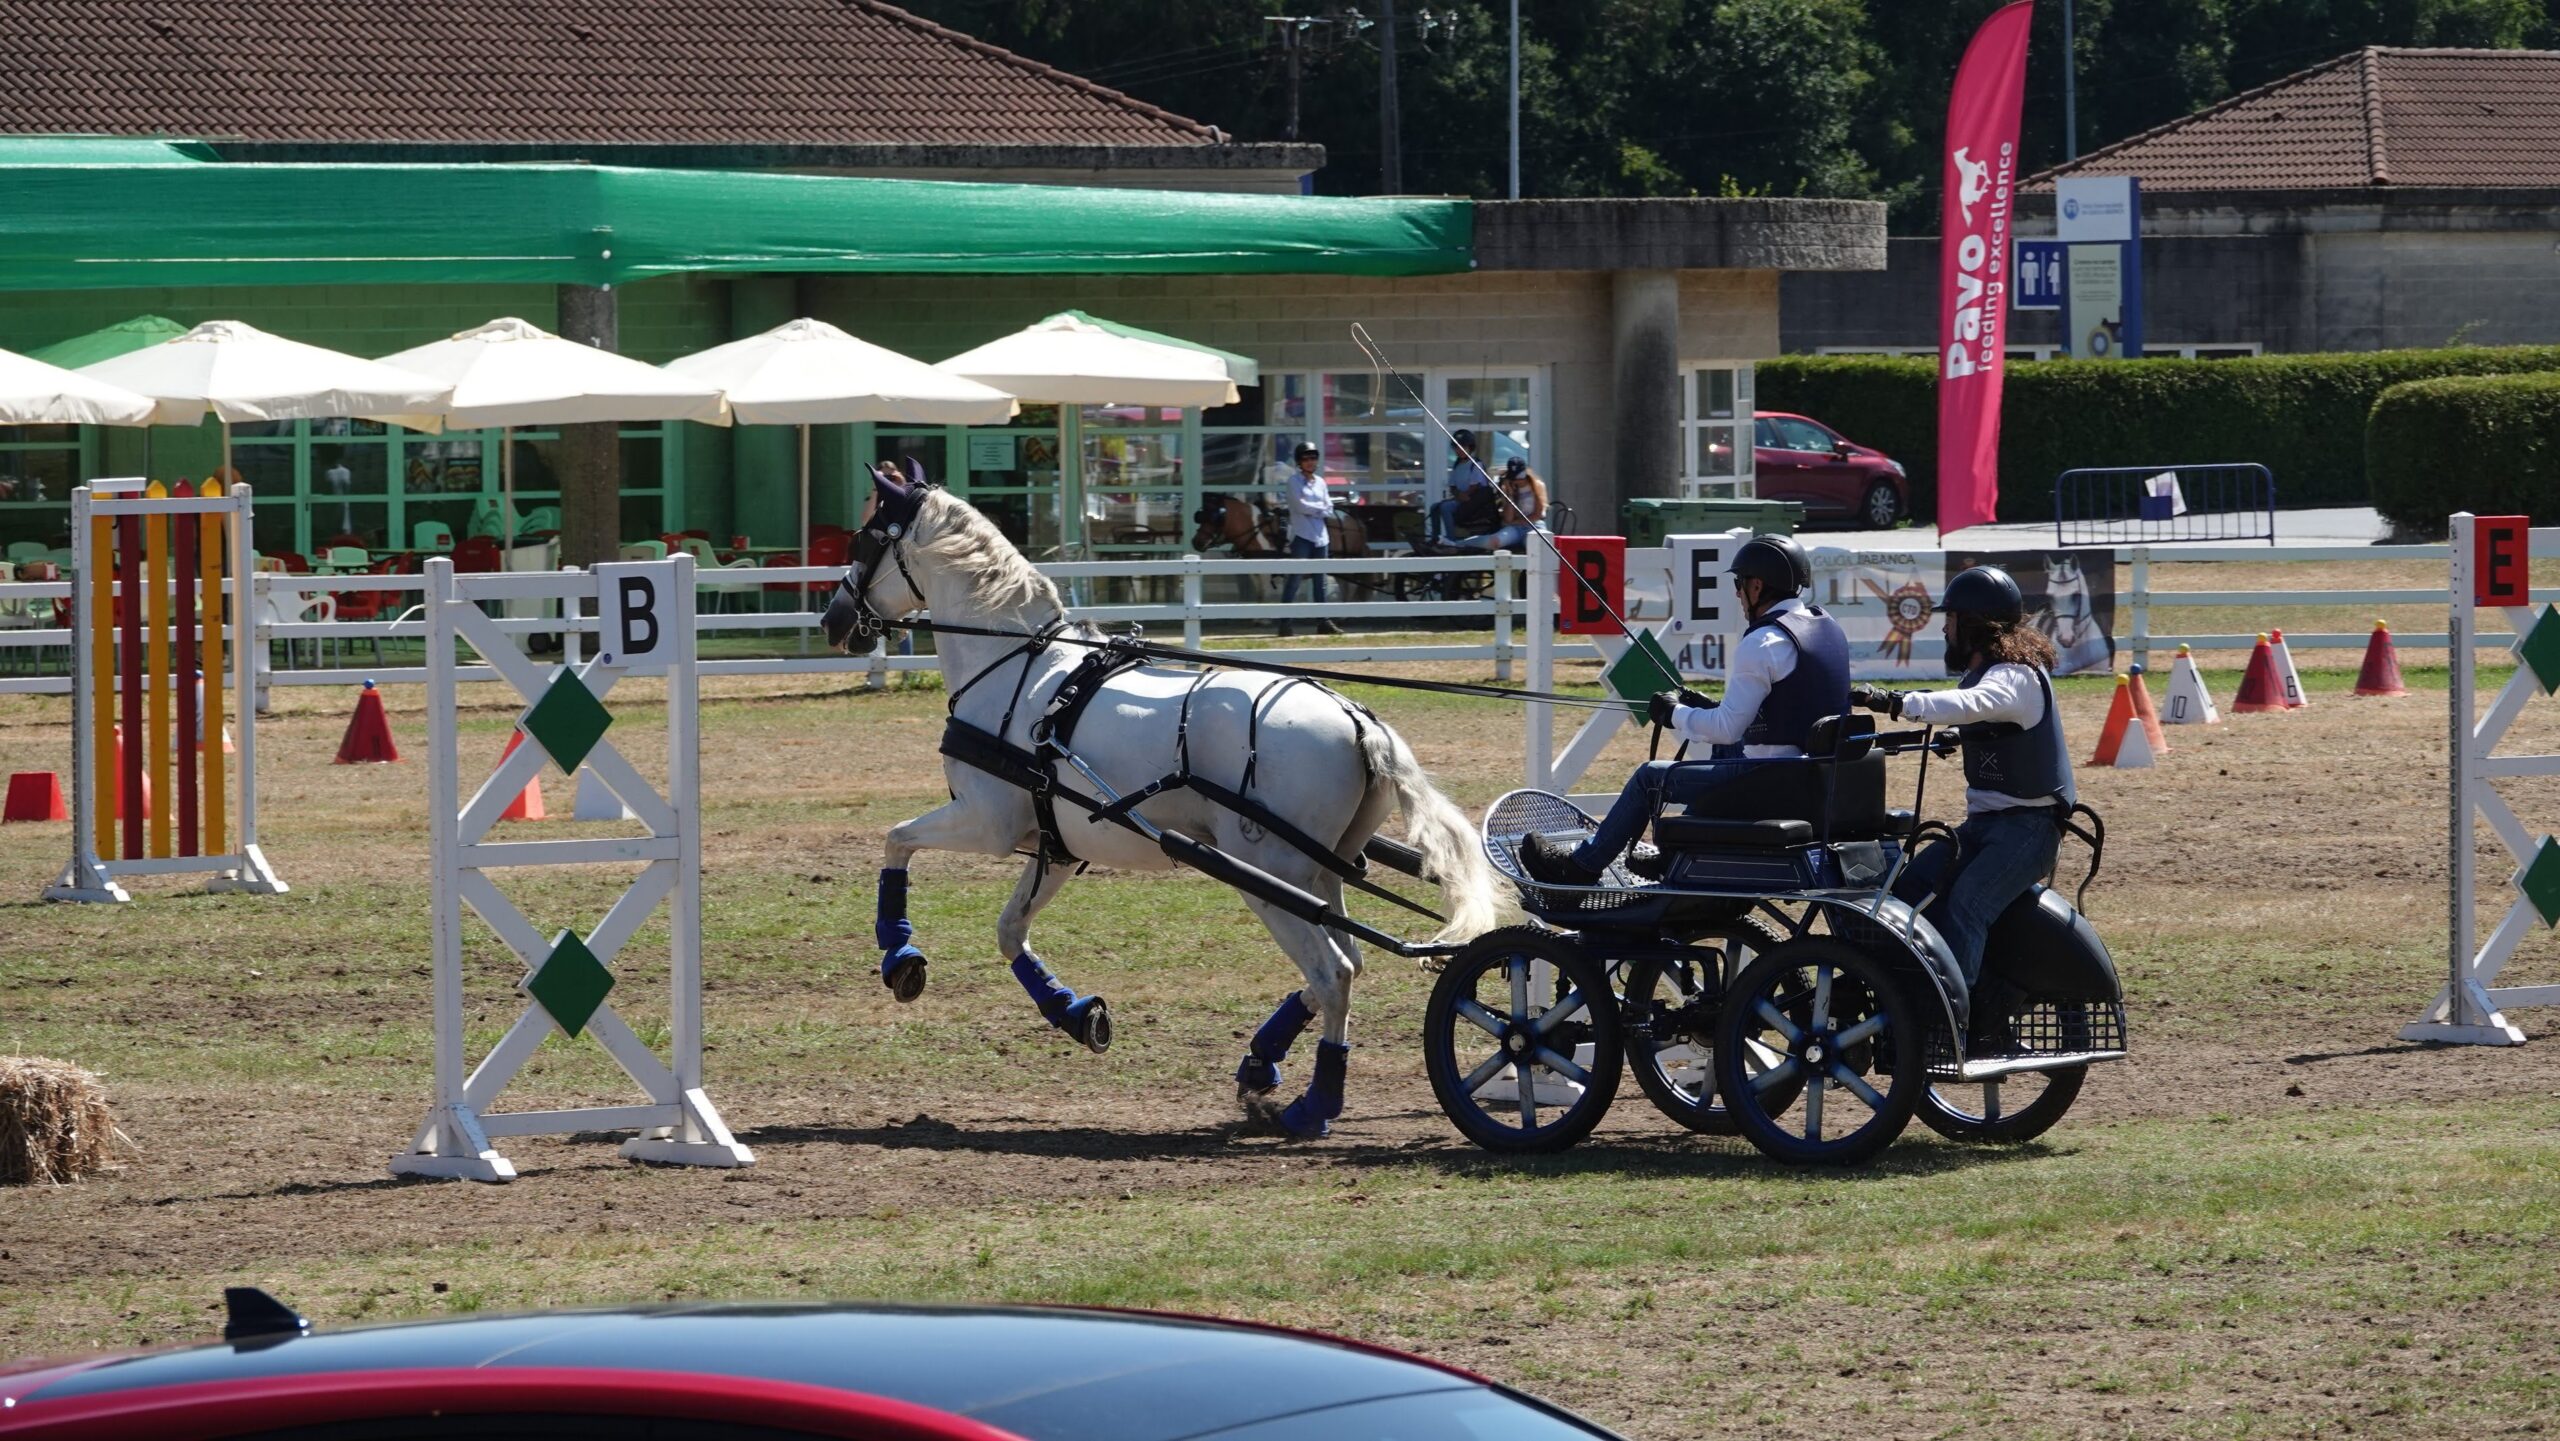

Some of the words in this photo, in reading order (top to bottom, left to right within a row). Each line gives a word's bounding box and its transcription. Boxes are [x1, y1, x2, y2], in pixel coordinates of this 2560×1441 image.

[1989, 142, 2012, 274] excellence
[1946, 234, 1985, 379] Pavo
[1978, 281, 2003, 371] feeding
[1577, 550, 1607, 622] B
[1691, 549, 1719, 620] E
[2489, 528, 2513, 595] E
[619, 576, 658, 654] B
[2171, 695, 2187, 719] 10
